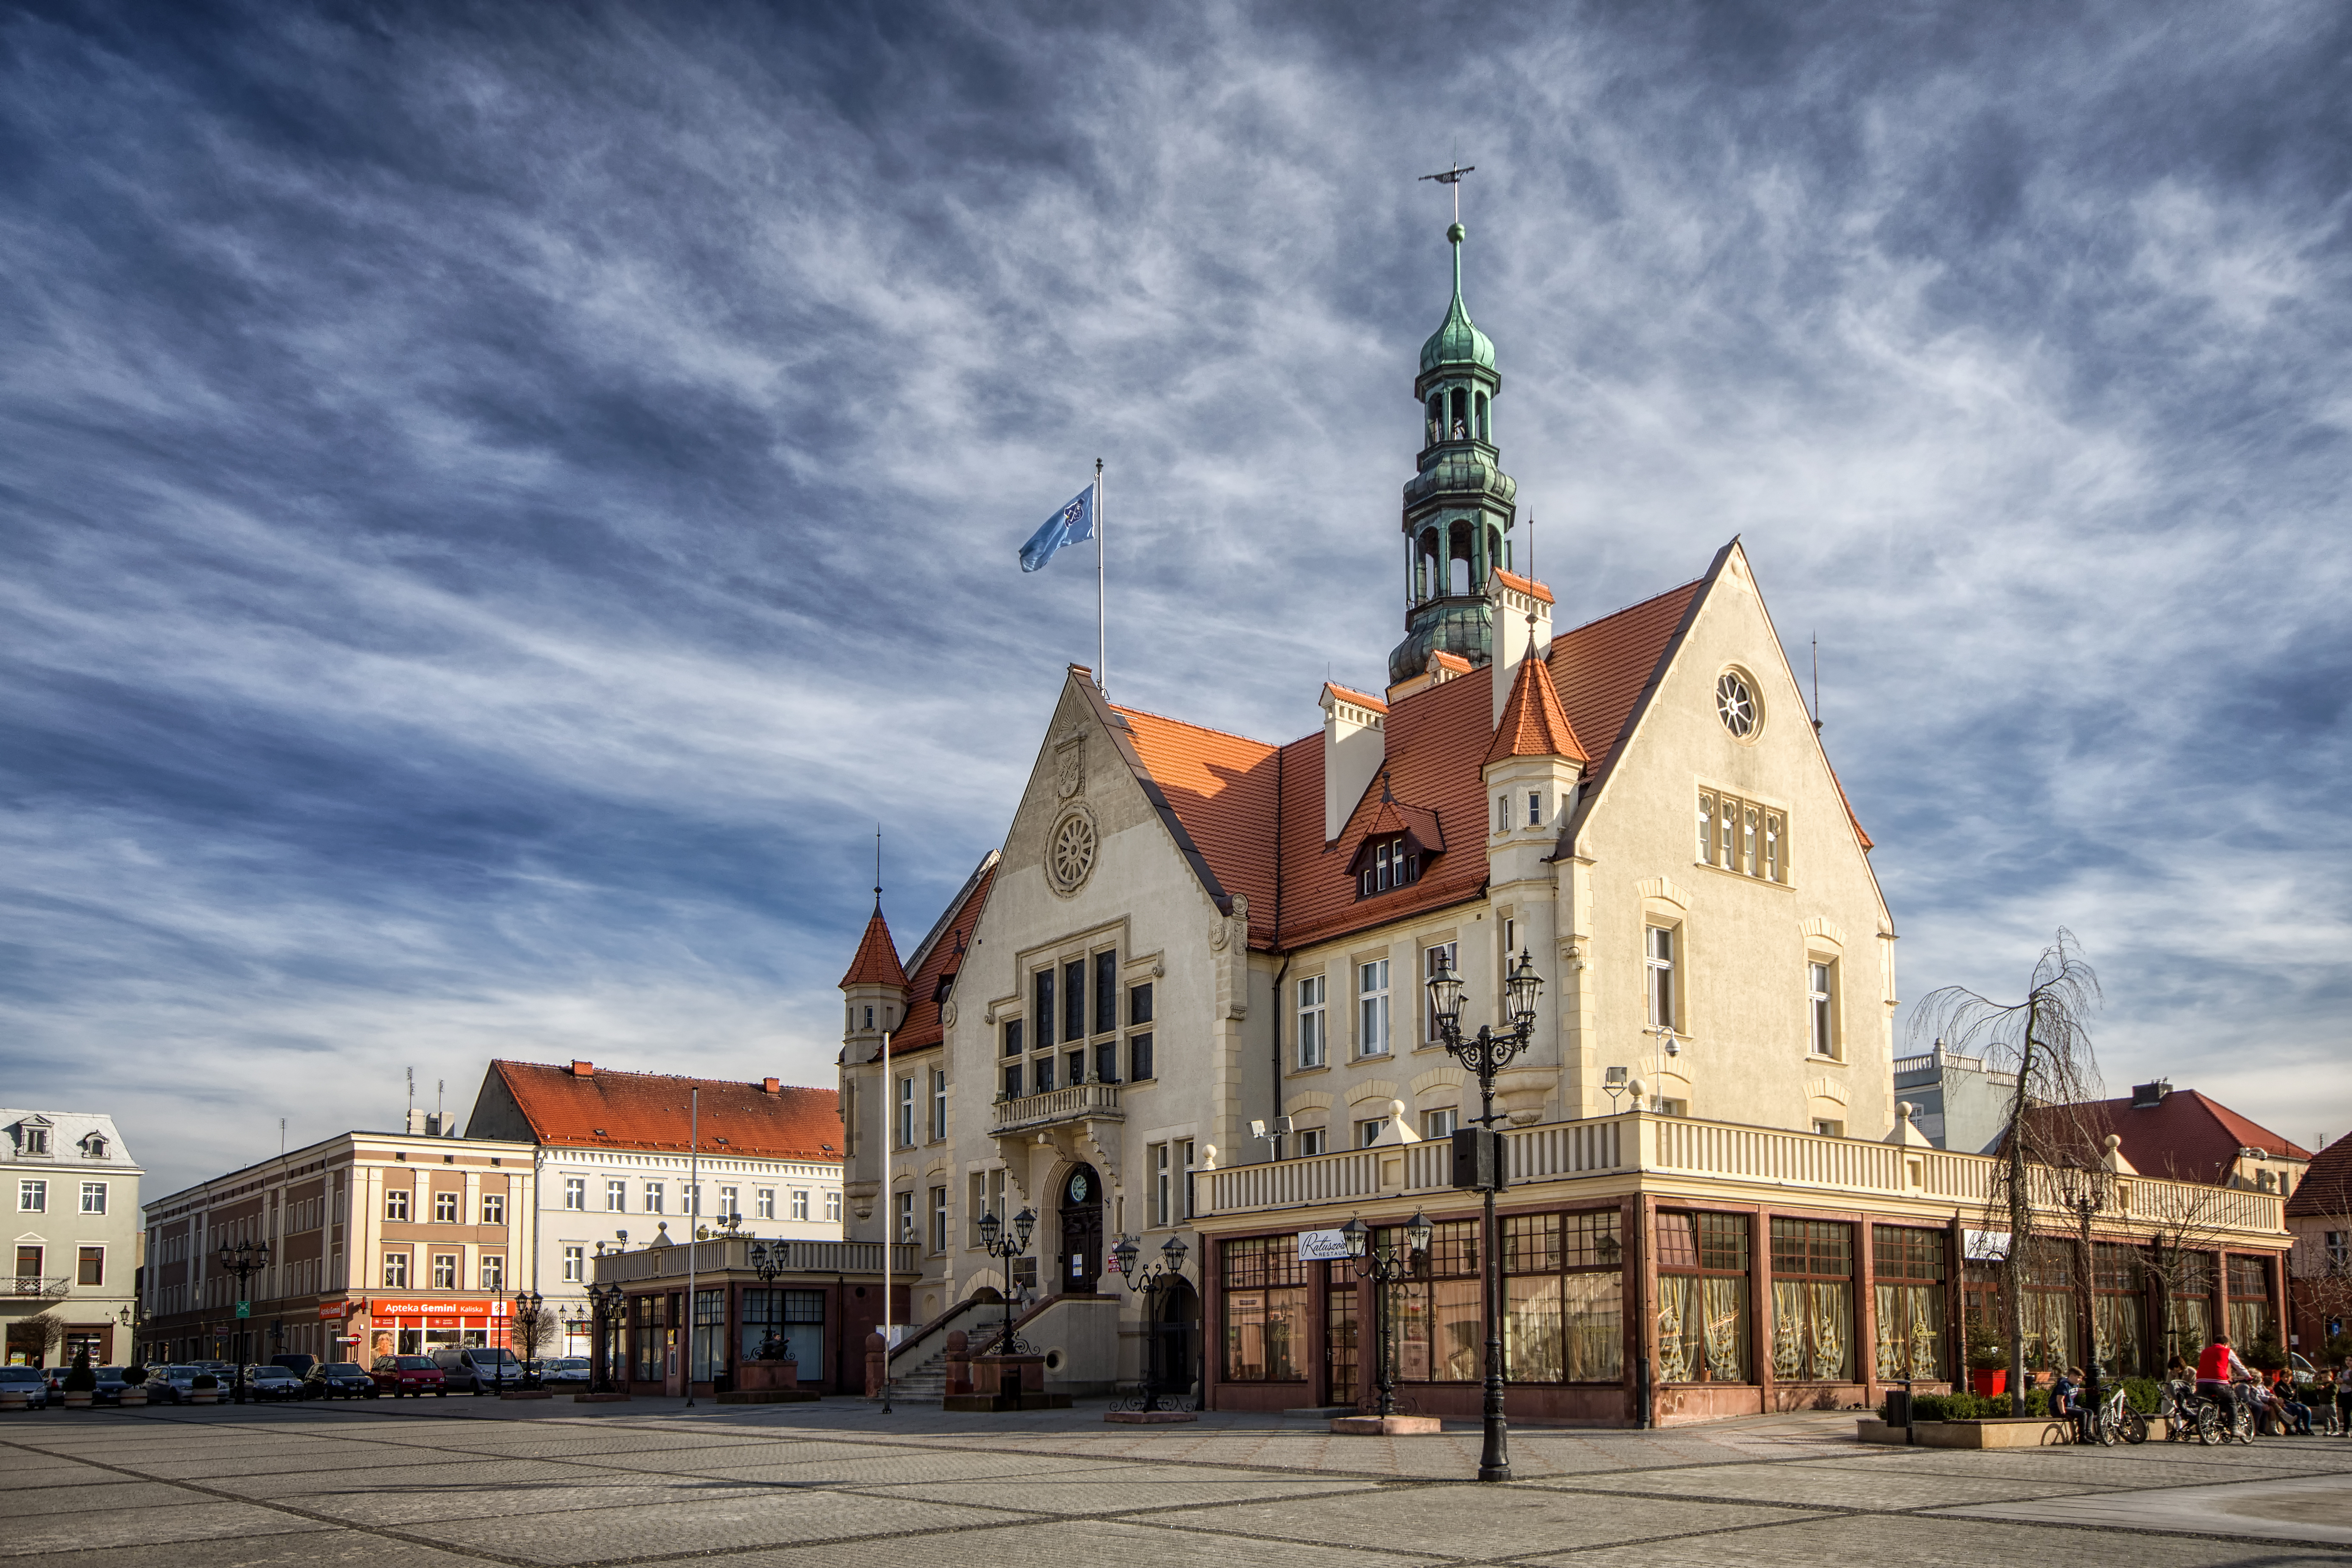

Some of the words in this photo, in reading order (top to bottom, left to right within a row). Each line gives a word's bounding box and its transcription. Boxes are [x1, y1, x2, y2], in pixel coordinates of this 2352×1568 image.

[711, 1230, 730, 1238] Ban
[738, 1230, 755, 1239] olski
[1301, 1233, 1346, 1256] Ratuszow
[321, 1307, 330, 1317] Apteka
[330, 1305, 341, 1314] Gemini
[385, 1303, 419, 1314] Apteka
[420, 1303, 456, 1312] Gemini
